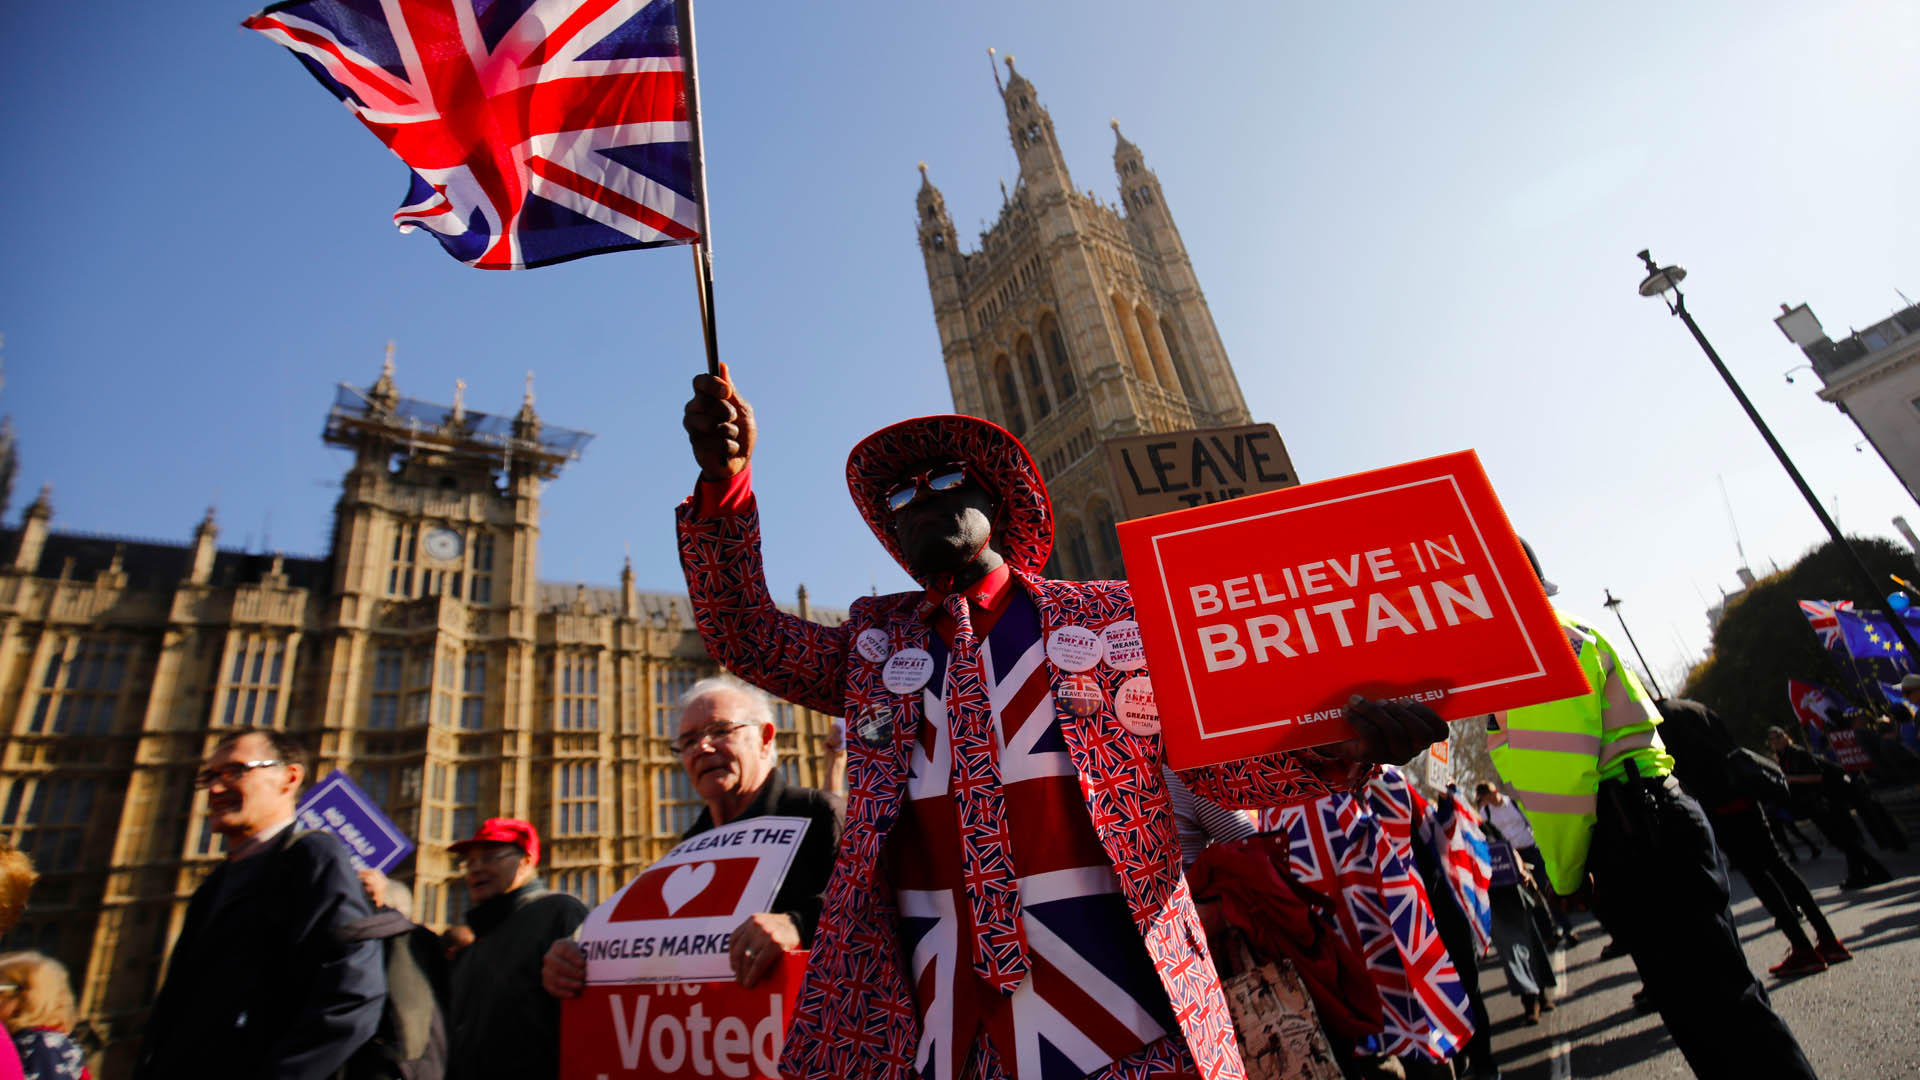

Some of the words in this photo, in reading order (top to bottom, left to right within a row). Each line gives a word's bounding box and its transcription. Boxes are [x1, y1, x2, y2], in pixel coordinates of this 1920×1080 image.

[1121, 432, 1288, 496] LEAVE
[1189, 547, 1401, 617] BELIEVE
[1410, 534, 1466, 573] IN
[1197, 574, 1494, 674] BRITAIN
[866, 635, 887, 656] VOTED
[1112, 640, 1140, 650] MEANS
[1061, 690, 1082, 698] LEAVE
[1126, 712, 1160, 721] GREATER
[685, 830, 746, 853] LEAVE
[751, 828, 796, 845] THE
[580, 937, 656, 961] SINGLES
[659, 933, 731, 957] MARKE
[609, 994, 783, 1079] Voted
